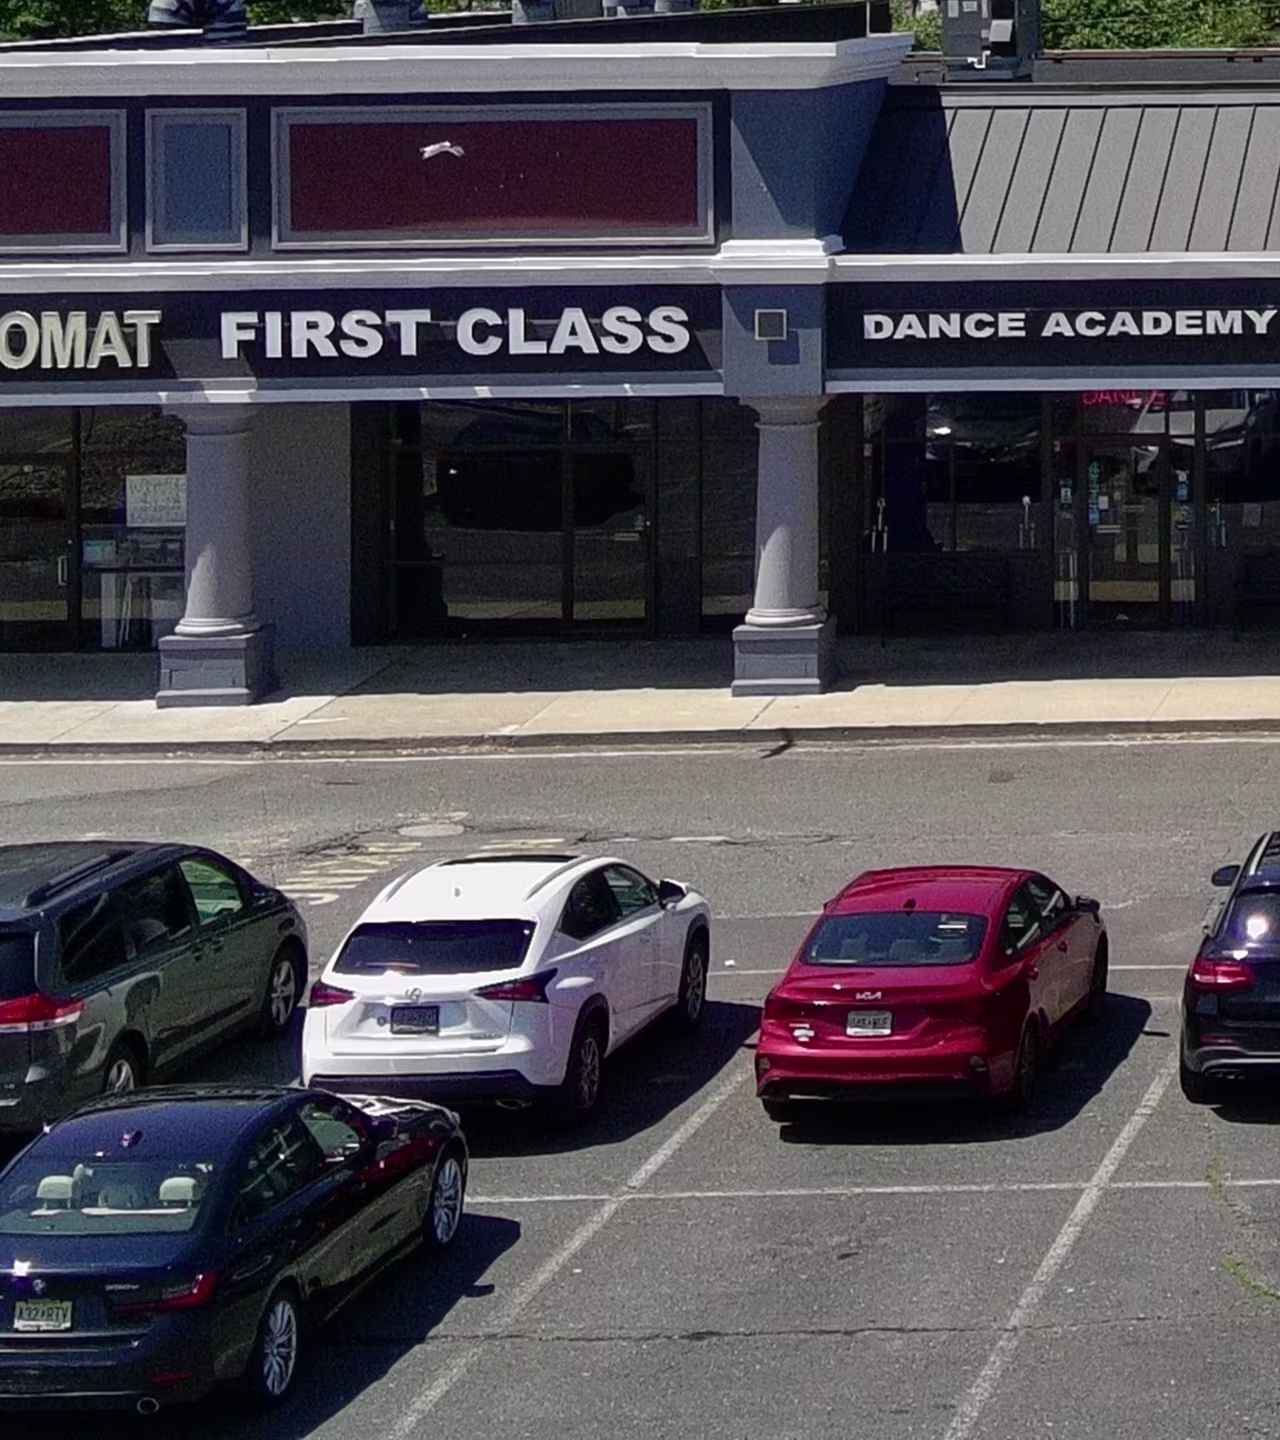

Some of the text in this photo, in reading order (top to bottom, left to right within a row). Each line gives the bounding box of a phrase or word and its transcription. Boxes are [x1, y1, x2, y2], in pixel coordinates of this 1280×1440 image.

[0, 311, 162, 369] OMAT
[220, 306, 691, 359] FIRST CLASS
[863, 309, 1278, 339] DANCE ACADEMY
